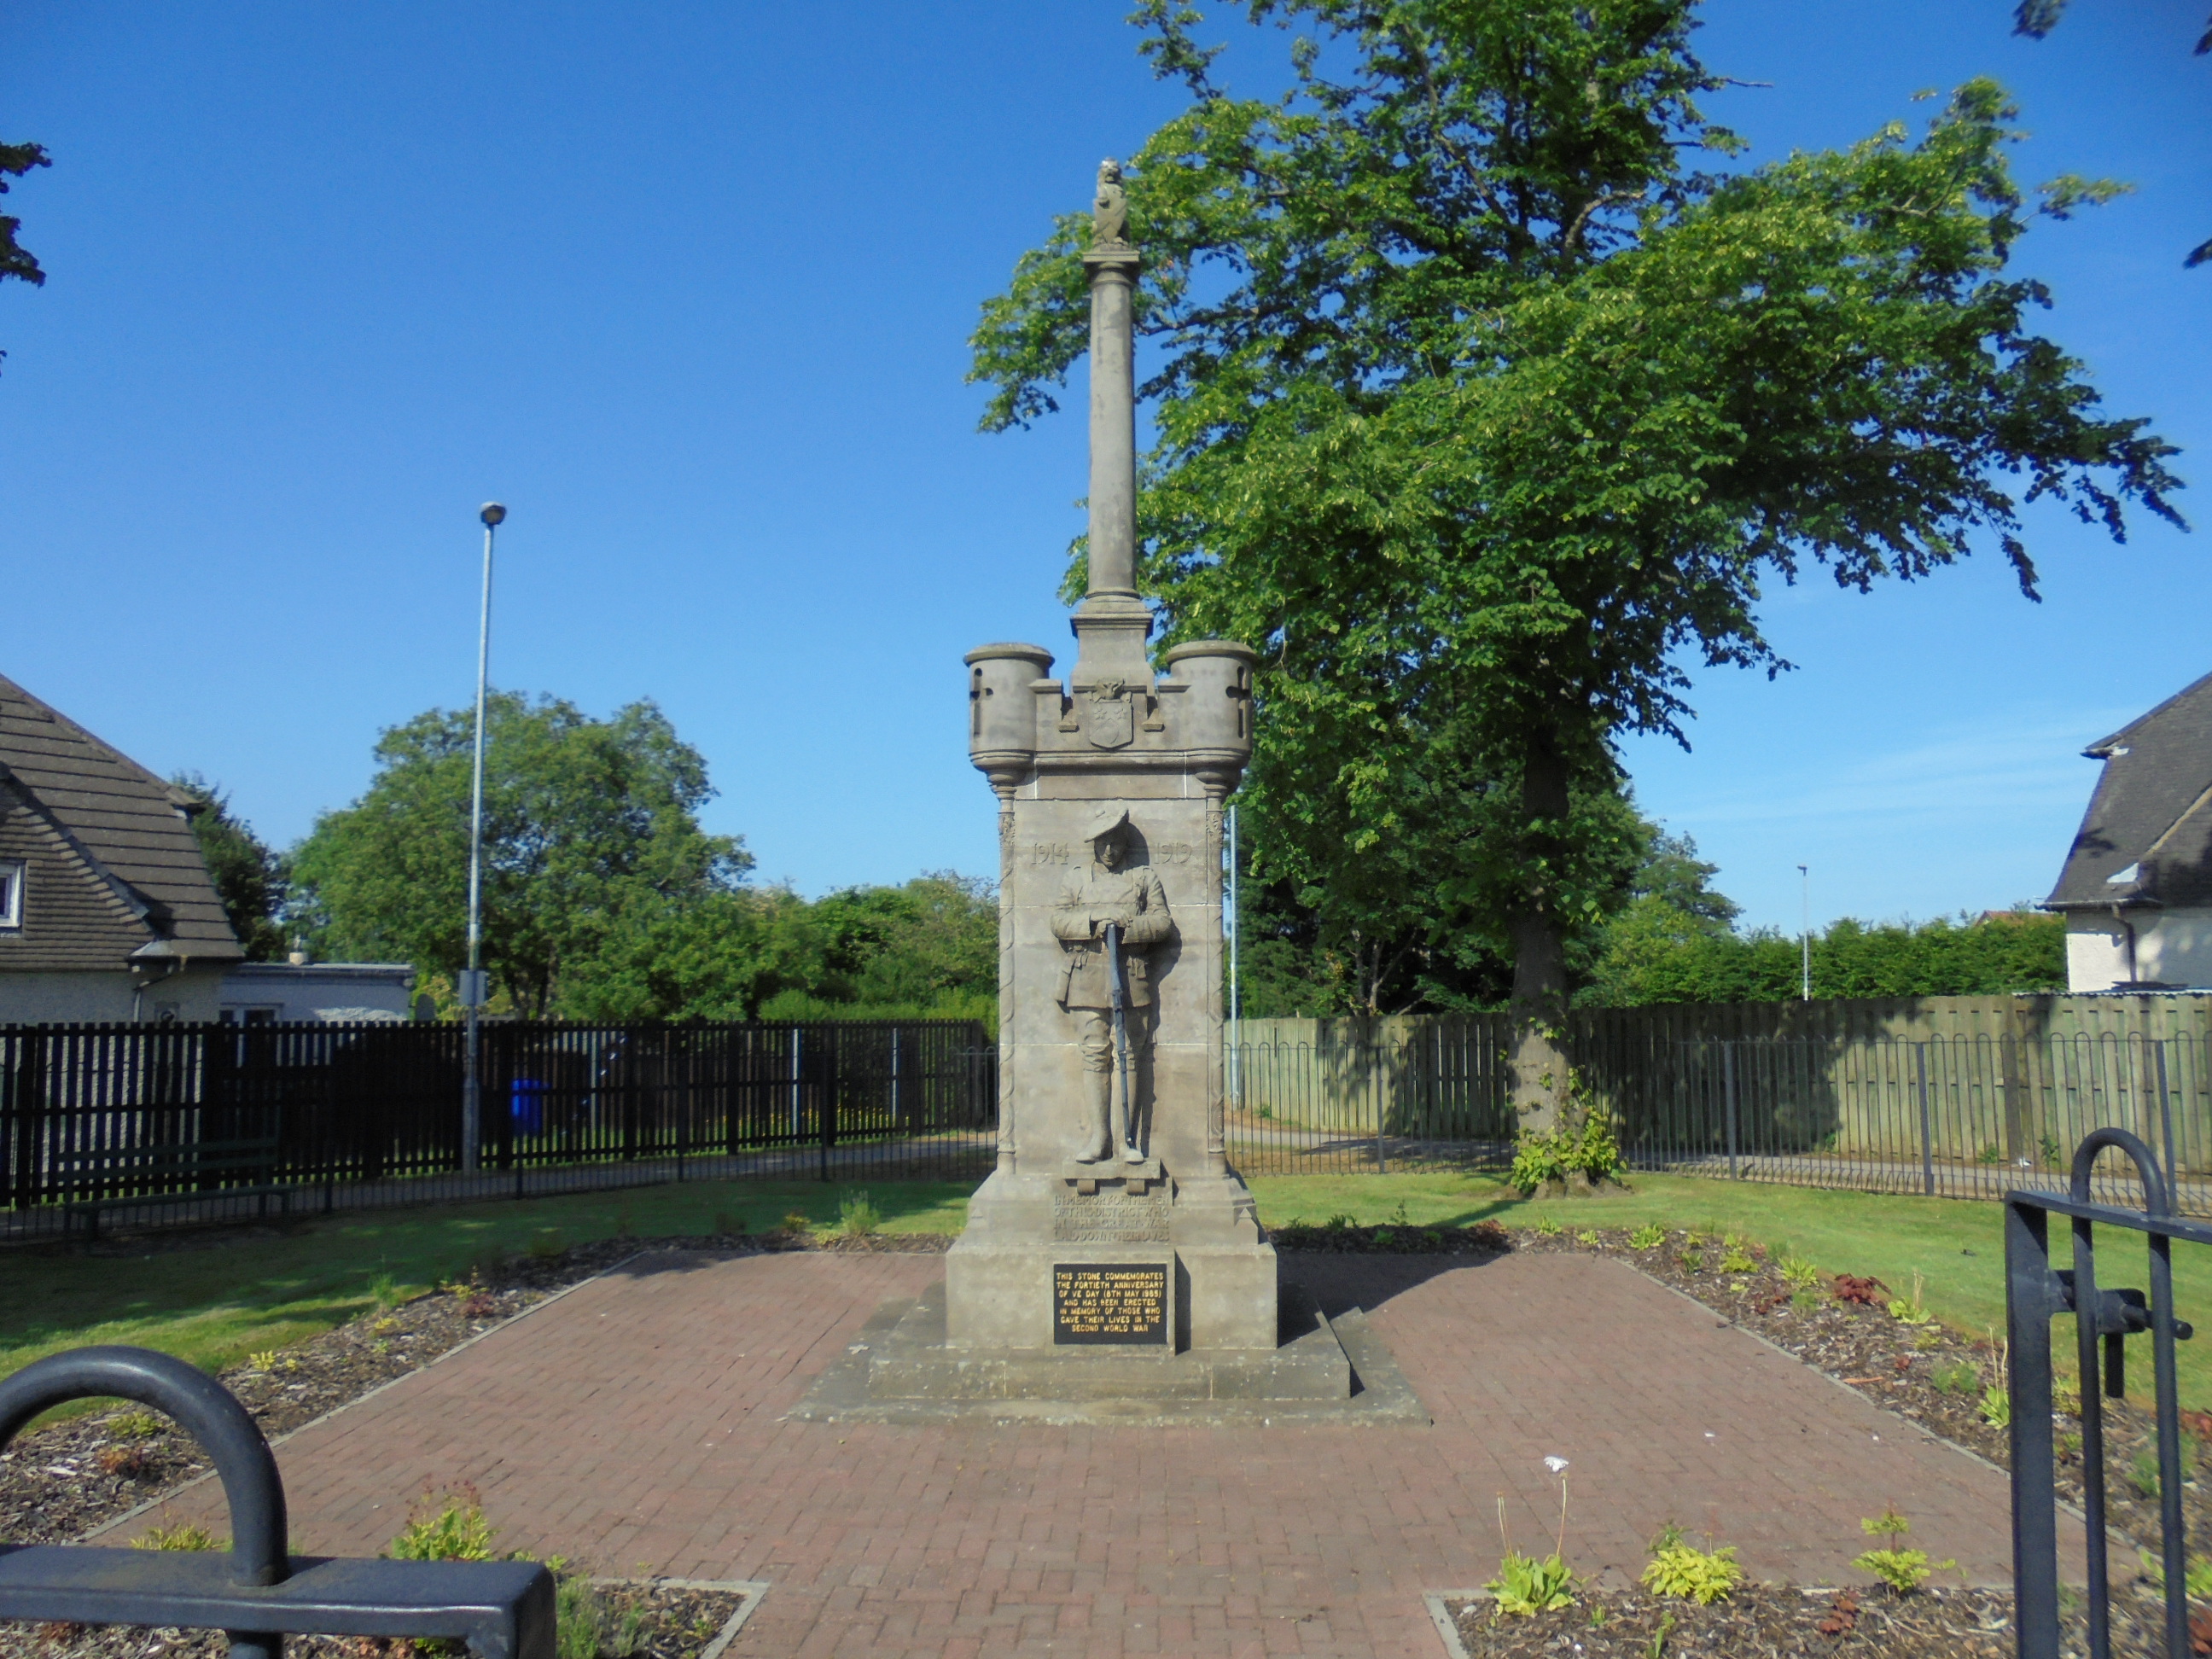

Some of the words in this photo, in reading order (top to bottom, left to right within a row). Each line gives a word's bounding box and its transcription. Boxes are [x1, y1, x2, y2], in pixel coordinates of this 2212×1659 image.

[1031, 842, 1069, 865] 1914
[1154, 842, 1192, 864] 1919
[1144, 1207, 1169, 1218] WHO
